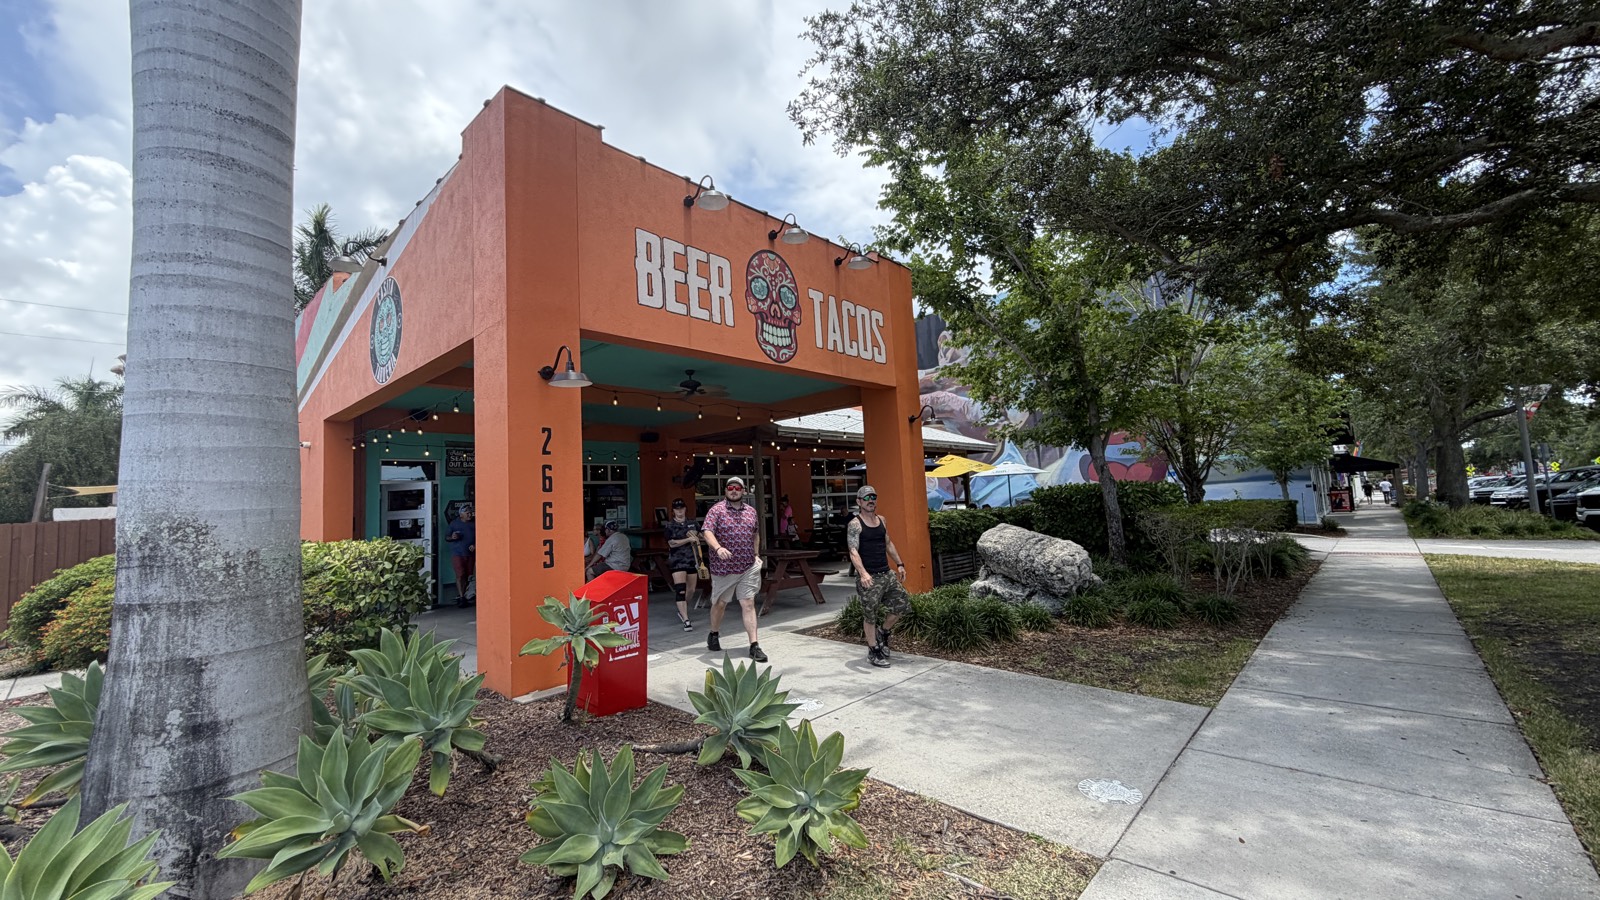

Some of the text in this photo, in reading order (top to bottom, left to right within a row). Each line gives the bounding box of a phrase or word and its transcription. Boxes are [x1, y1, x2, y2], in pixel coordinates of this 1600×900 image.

[635, 227, 886, 364] BEER TACOS
[614, 603, 640, 627] CL
